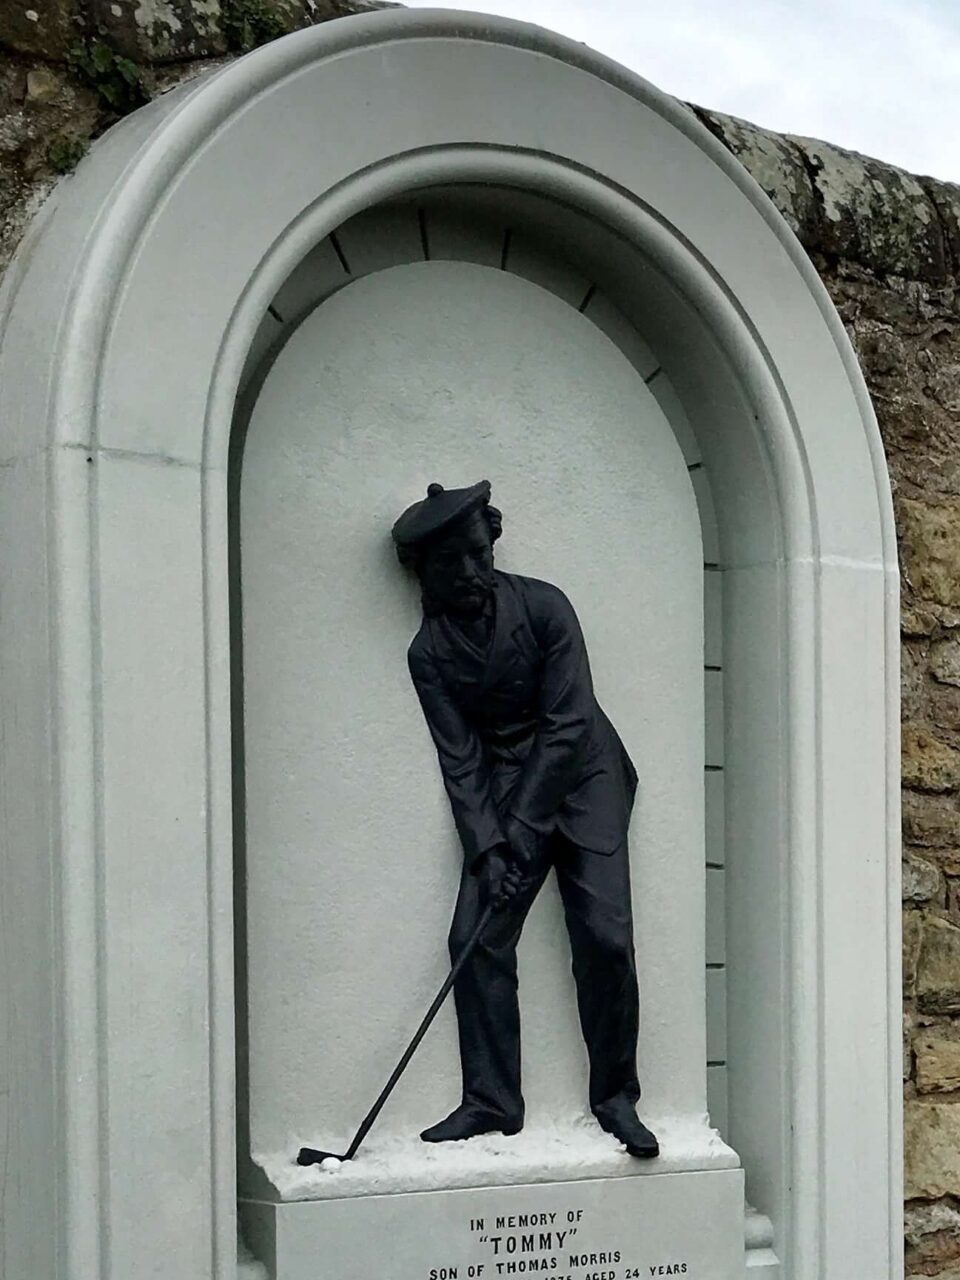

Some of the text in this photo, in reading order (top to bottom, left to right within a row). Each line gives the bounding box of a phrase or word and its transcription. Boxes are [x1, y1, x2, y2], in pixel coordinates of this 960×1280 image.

[496, 1212, 557, 1229] MEMORY
[495, 1257, 557, 1275] THOMAS
[569, 1251, 621, 1268] MORRIS
[625, 1268, 640, 1279] 24
[649, 1263, 687, 1276] YEARS
